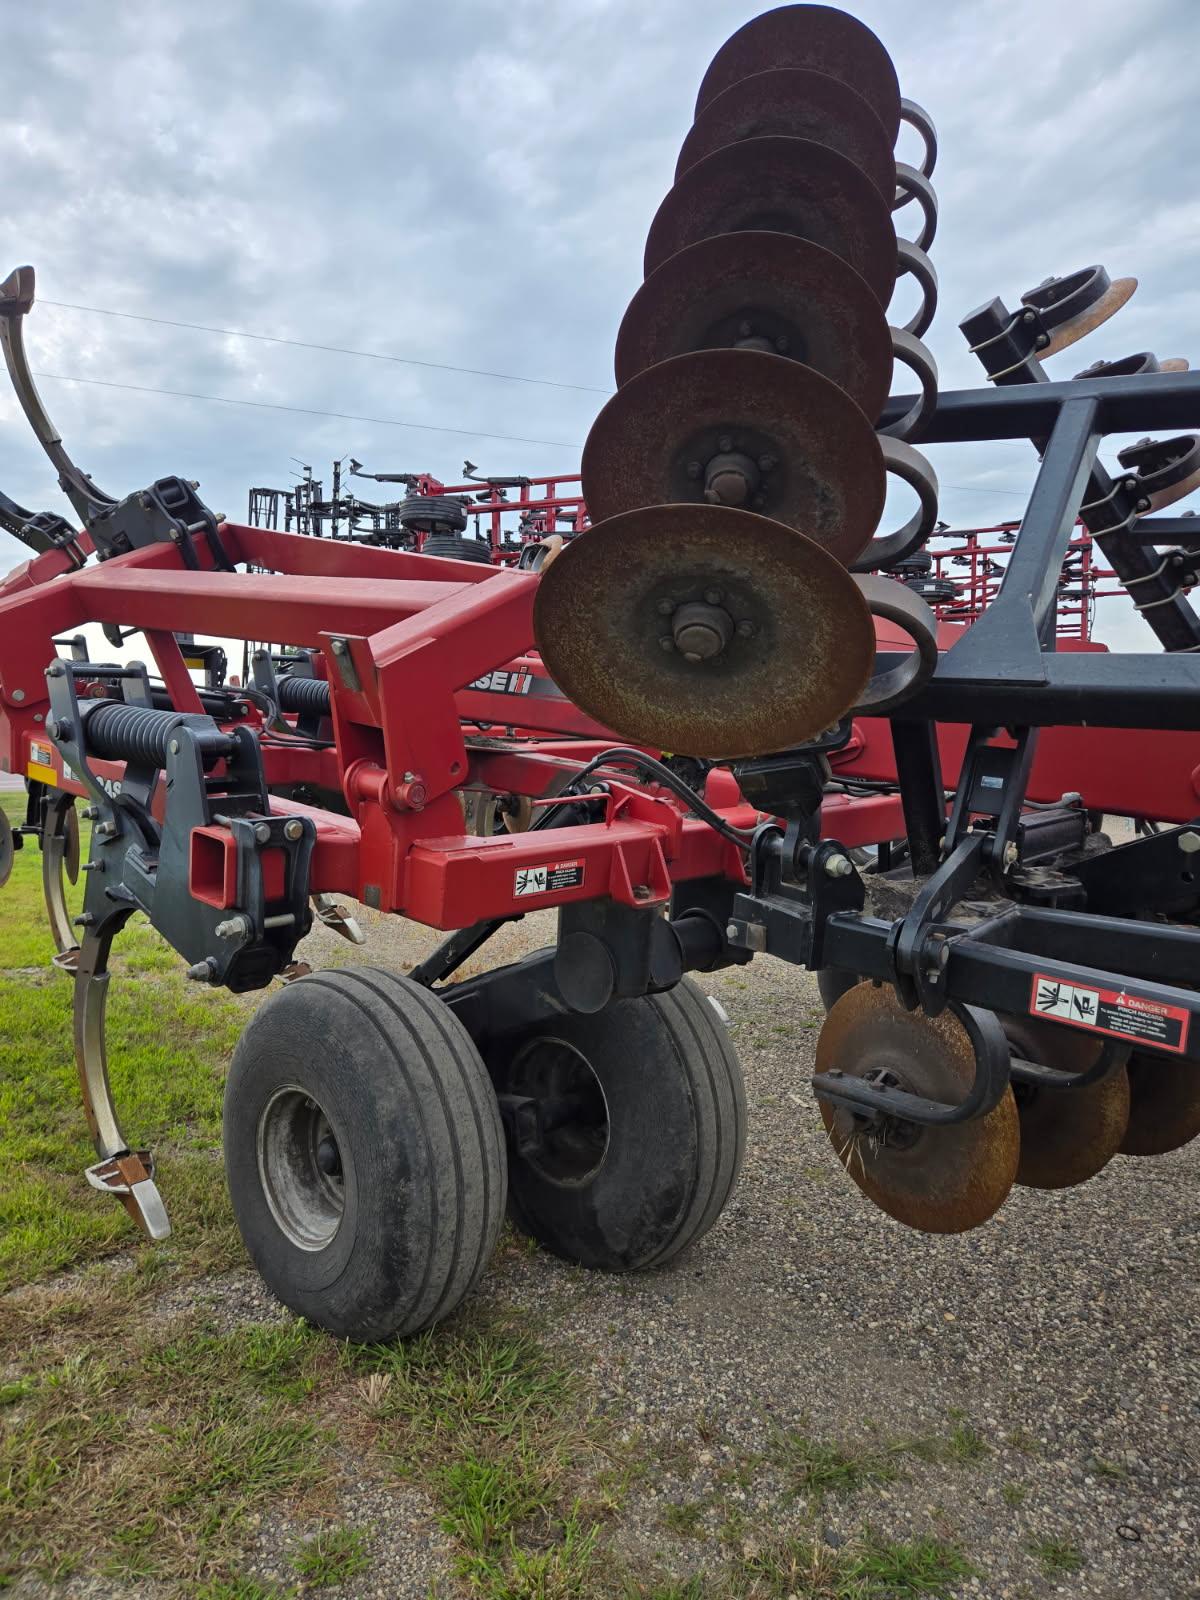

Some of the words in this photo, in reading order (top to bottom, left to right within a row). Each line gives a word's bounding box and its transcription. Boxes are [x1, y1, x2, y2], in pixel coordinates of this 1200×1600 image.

[468, 671, 508, 691] SE
[1117, 1005, 1137, 1015] PINCH
[1137, 1010, 1164, 1022] HAZARD
[1128, 999, 1168, 1015] DANGER
